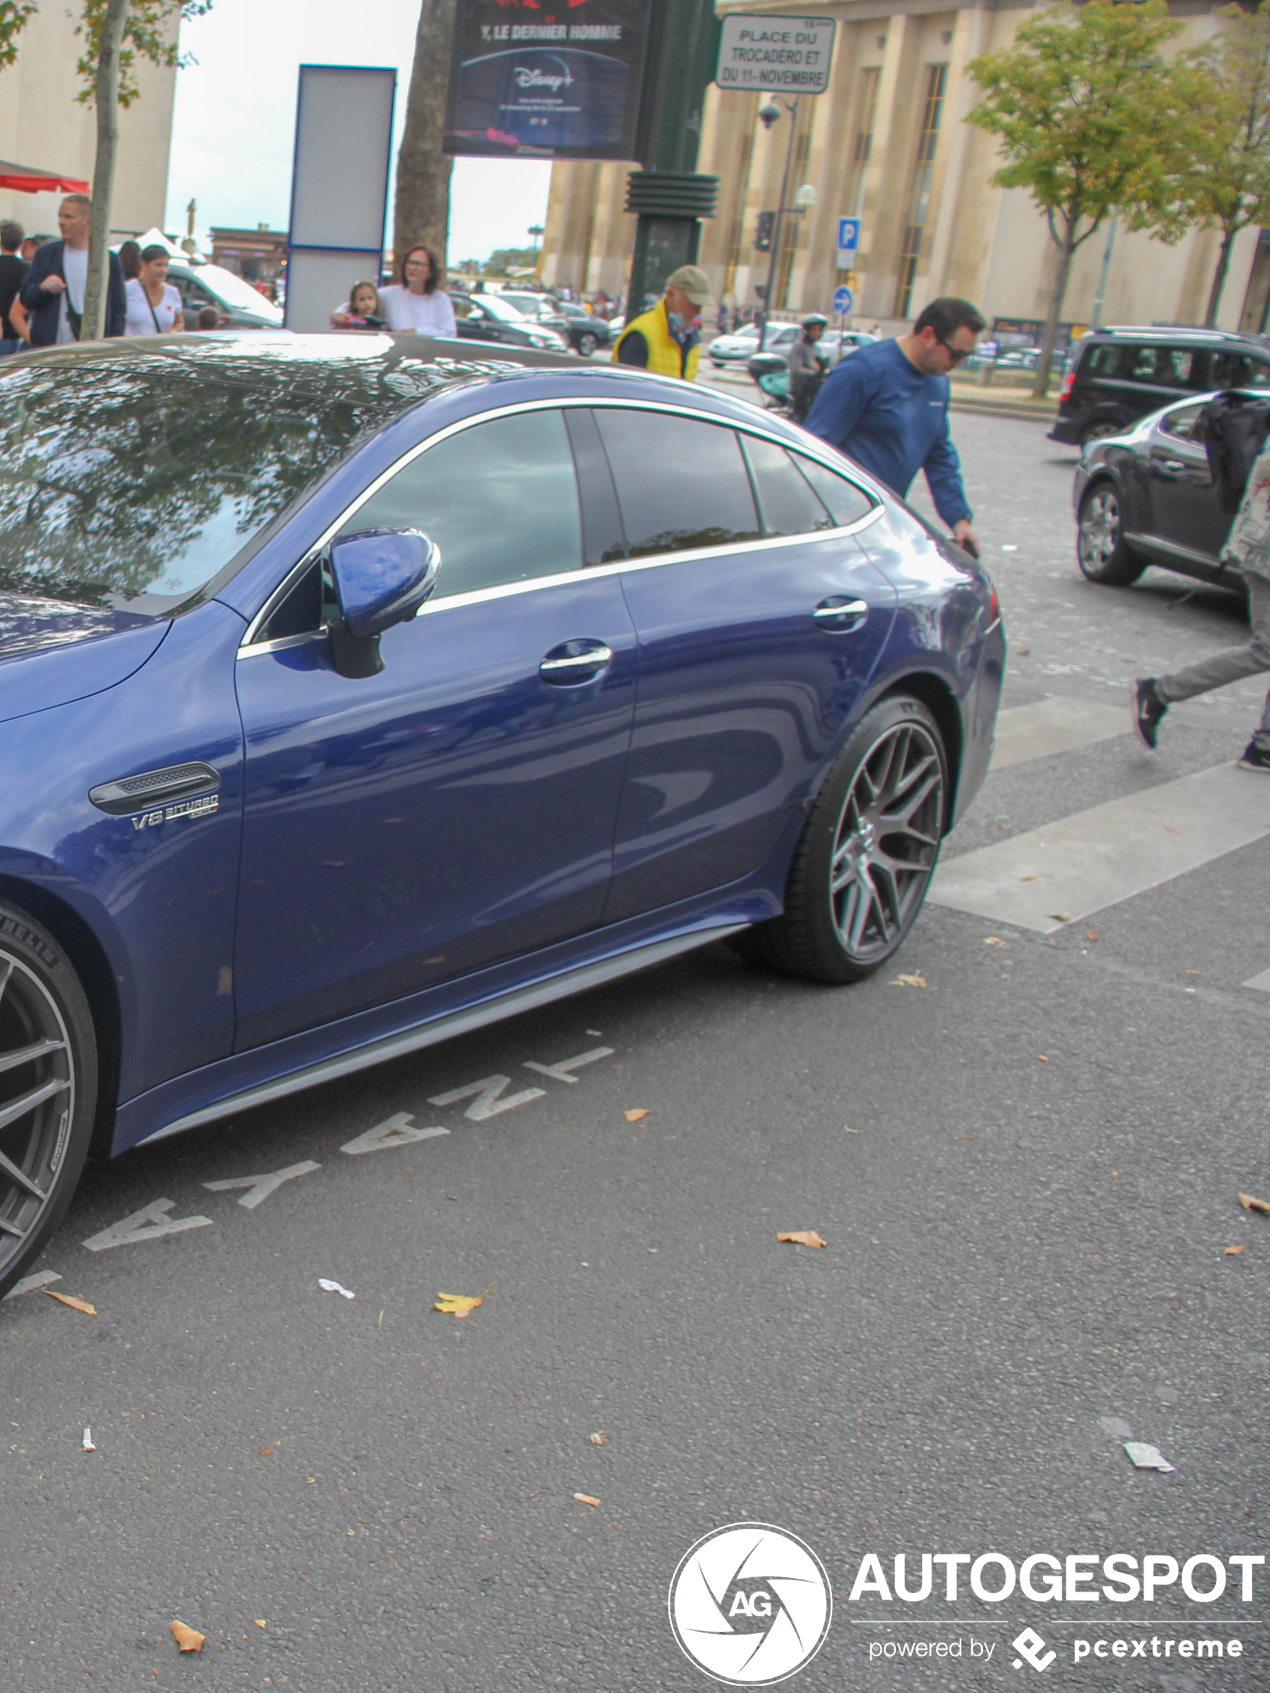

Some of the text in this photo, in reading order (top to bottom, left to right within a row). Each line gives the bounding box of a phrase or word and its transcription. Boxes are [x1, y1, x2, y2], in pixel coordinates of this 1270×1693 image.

[481, 25, 622, 41] Y, LE DERNIER HOMME
[739, 30, 818, 44] PLACE DU
[732, 46, 821, 65] TROCADÉRO ET
[722, 67, 739, 81] DU
[759, 69, 824, 86] NOVEMBRE
[843, 224, 855, 245] P
[131, 794, 219, 830] V8 BITURBO
[2, 1046, 615, 1300] AYANT
